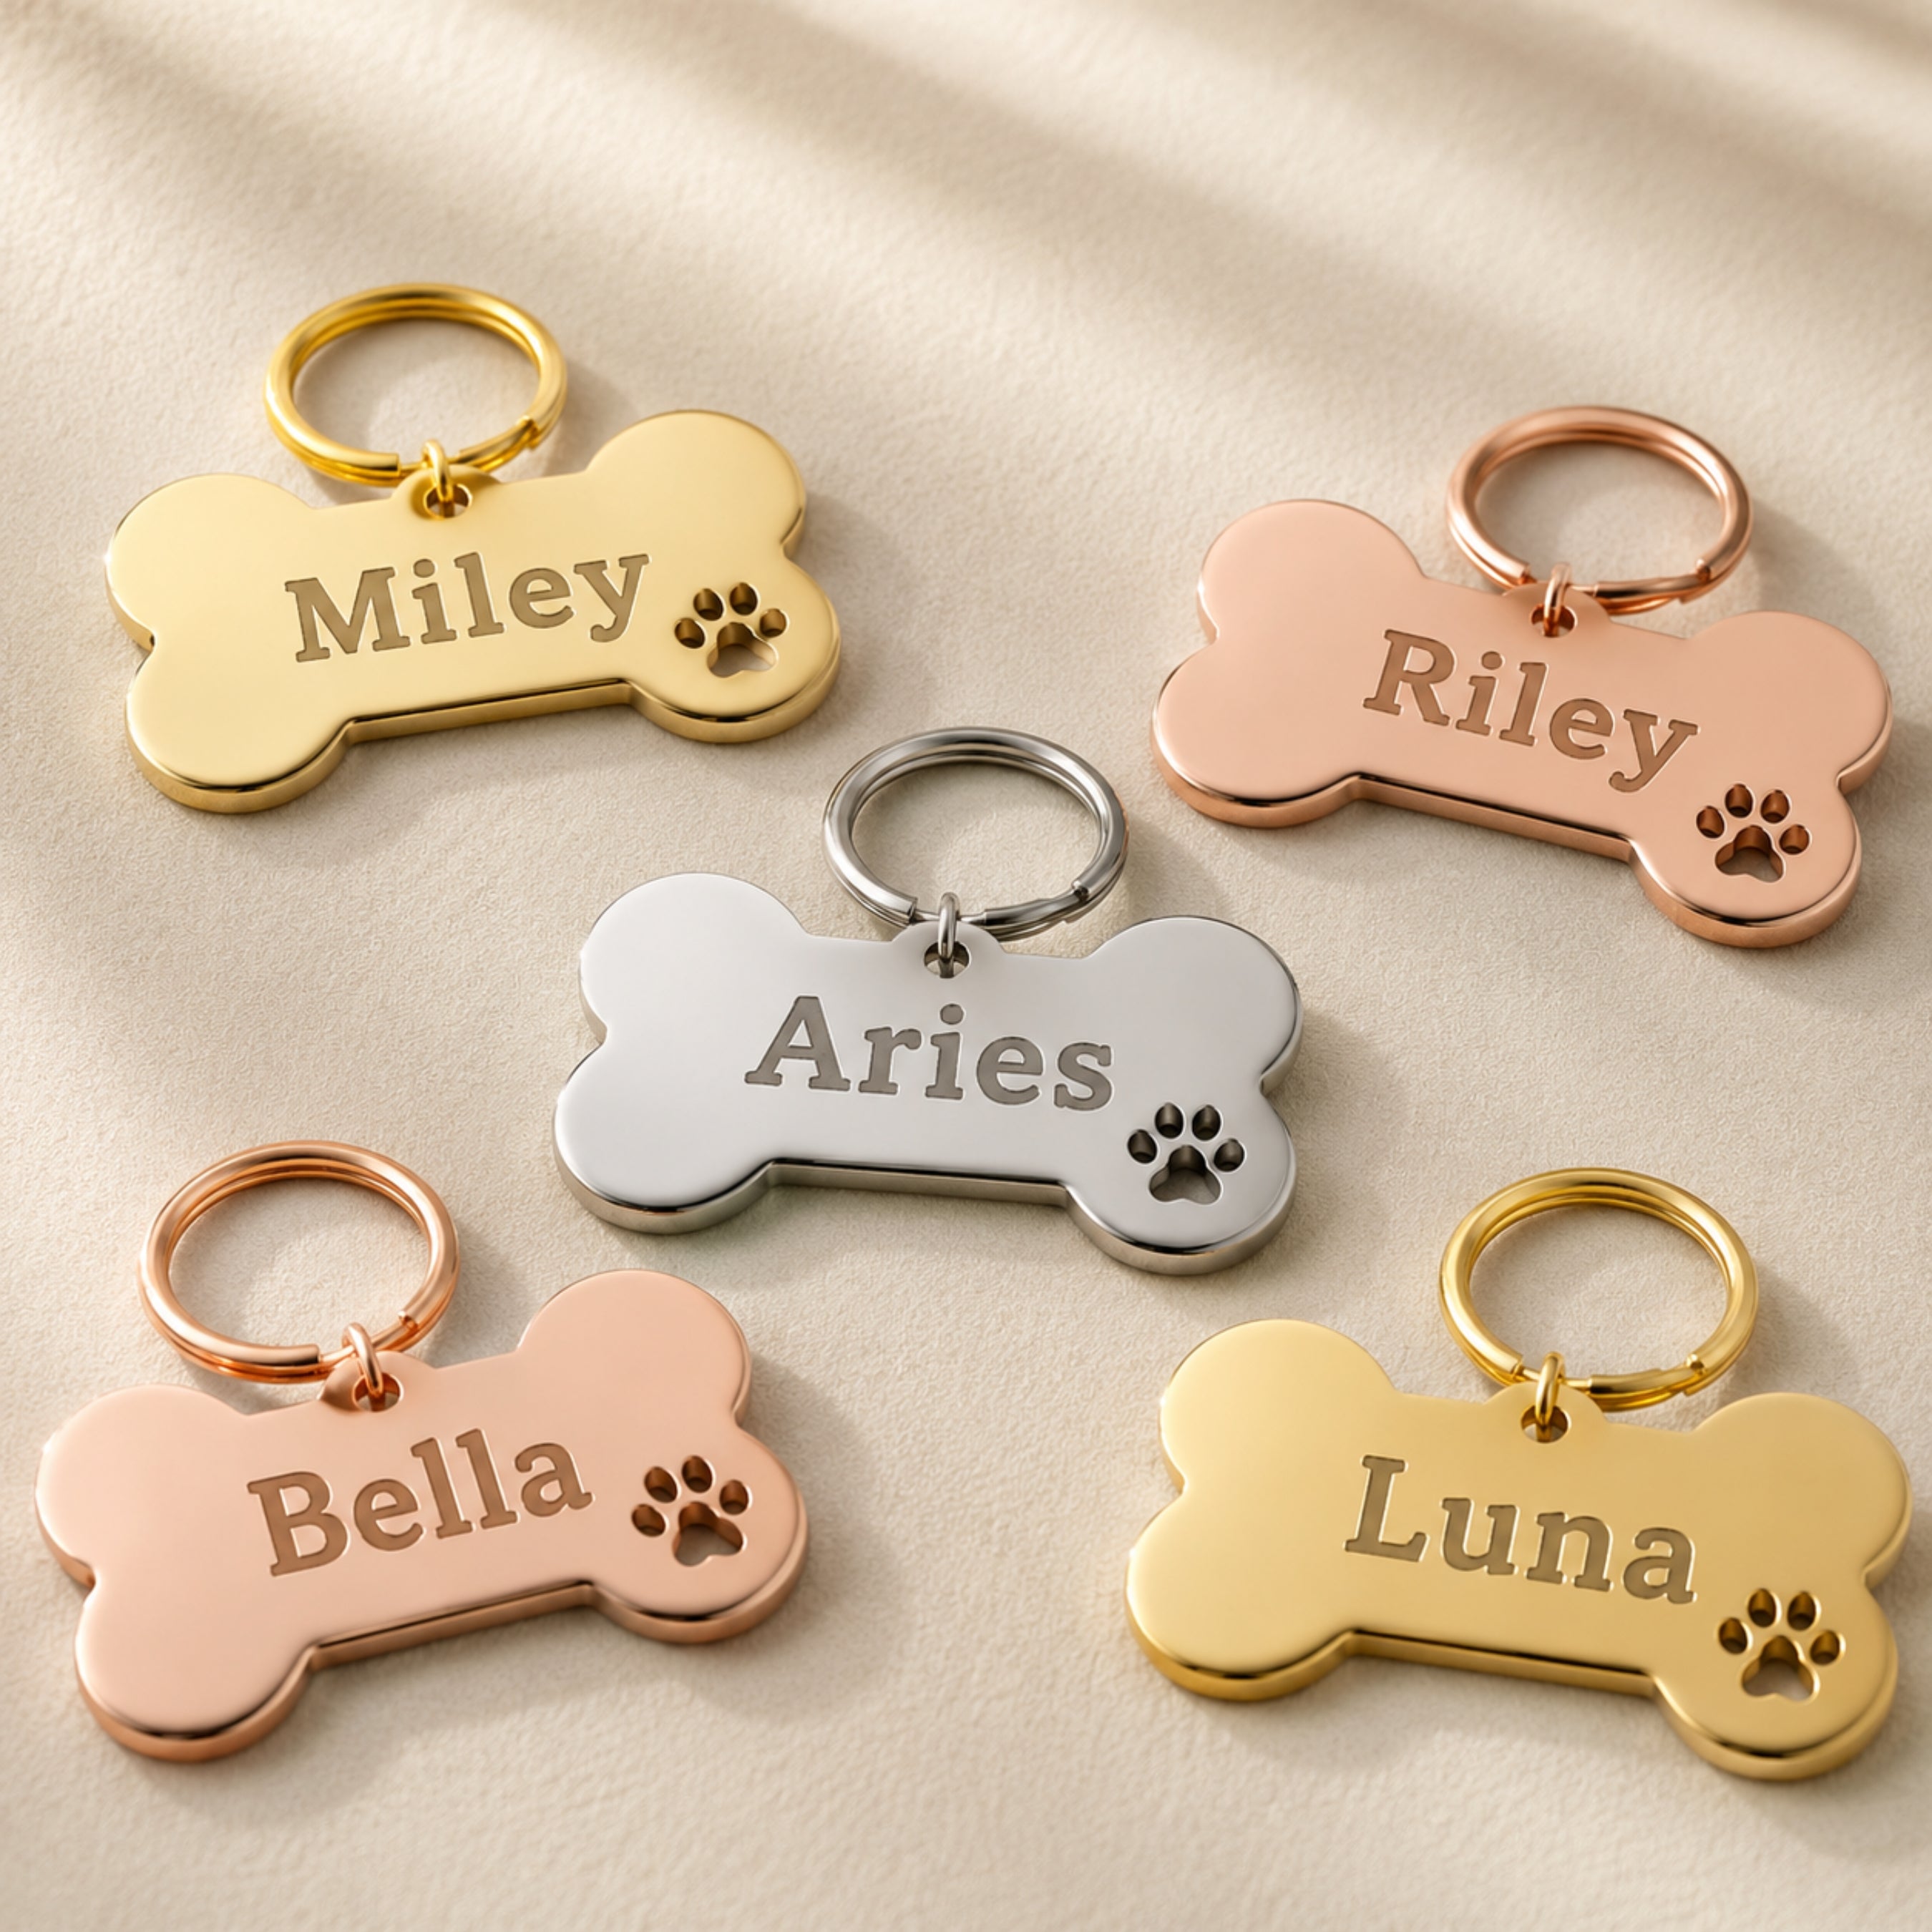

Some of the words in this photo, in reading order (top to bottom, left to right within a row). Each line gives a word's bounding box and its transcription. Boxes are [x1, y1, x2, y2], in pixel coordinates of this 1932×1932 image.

[284, 551, 650, 663] Miley
[1362, 628, 1699, 794] Riley
[743, 995, 1112, 1112] Aries
[246, 1428, 592, 1577] Bella
[1345, 1454, 1696, 1605] Luna
